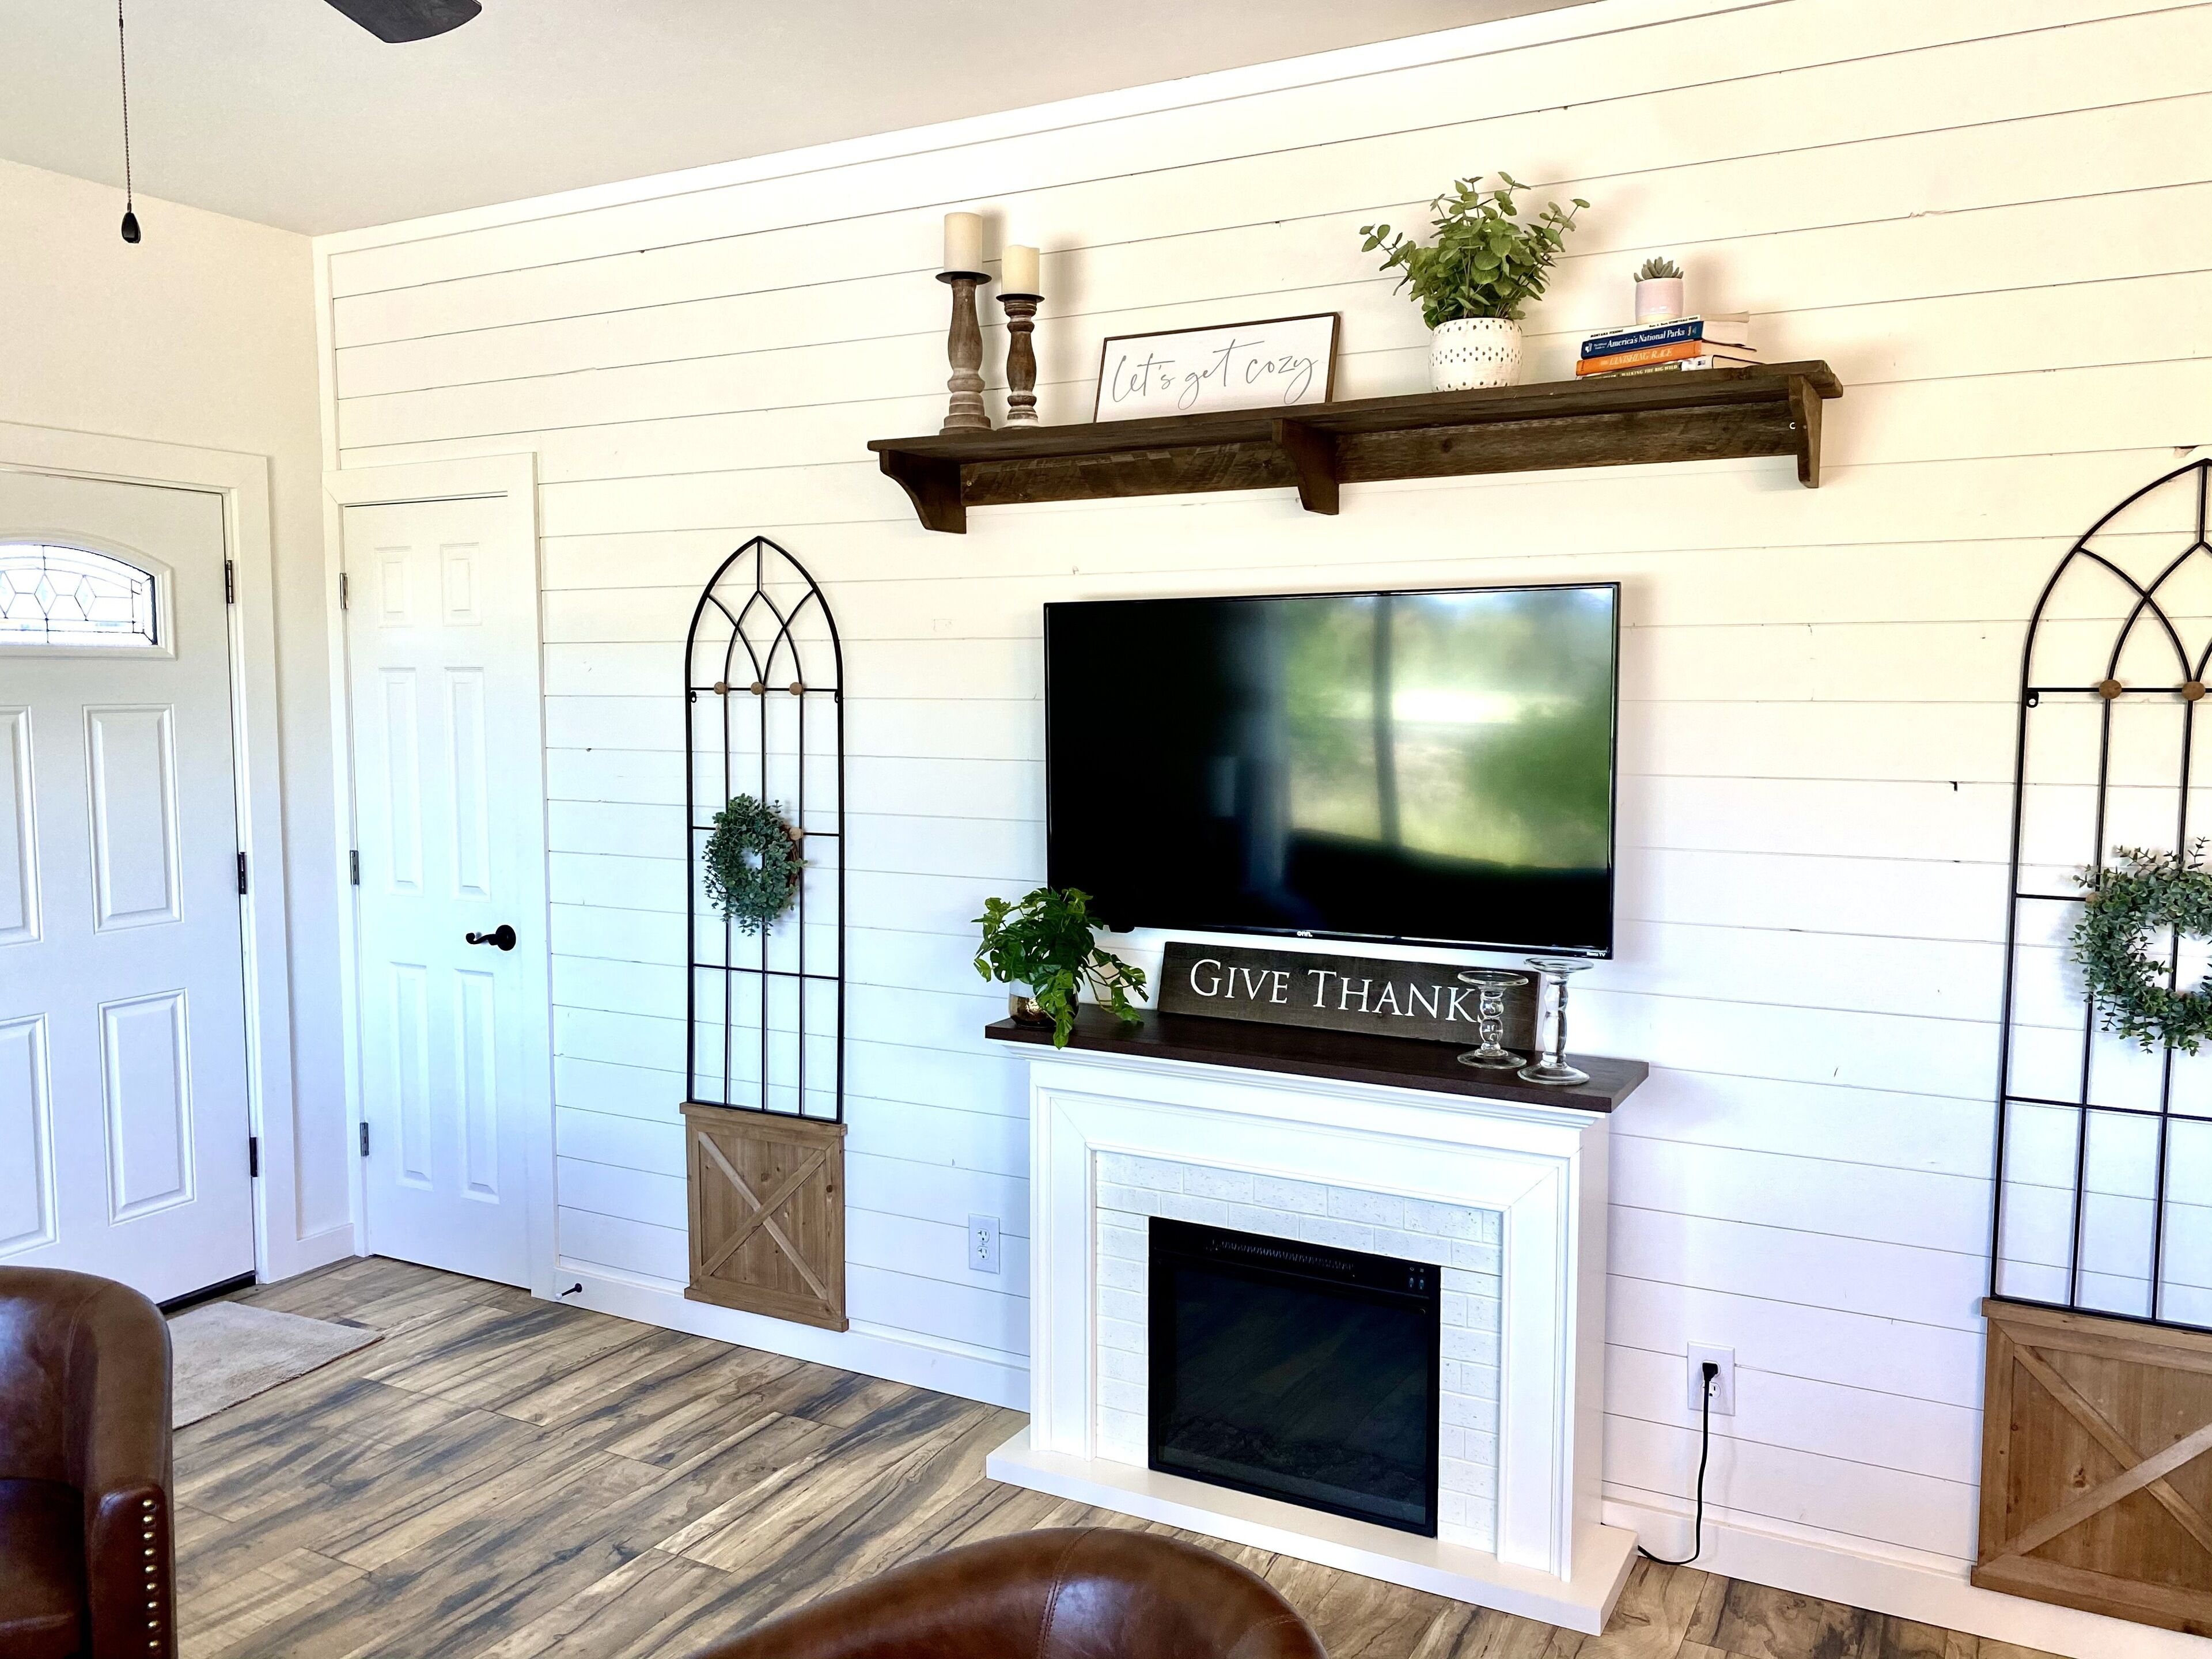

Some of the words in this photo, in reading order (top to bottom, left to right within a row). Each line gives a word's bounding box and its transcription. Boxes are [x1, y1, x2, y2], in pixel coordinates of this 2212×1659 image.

[1607, 336, 1638, 348] America's
[1638, 331, 1666, 342] National
[1666, 328, 1685, 338] Parks
[1178, 339, 1265, 410] get
[1245, 355, 1319, 405] cozy
[1190, 959, 1290, 1003] GIVE
[1308, 969, 1498, 1023] THANK
